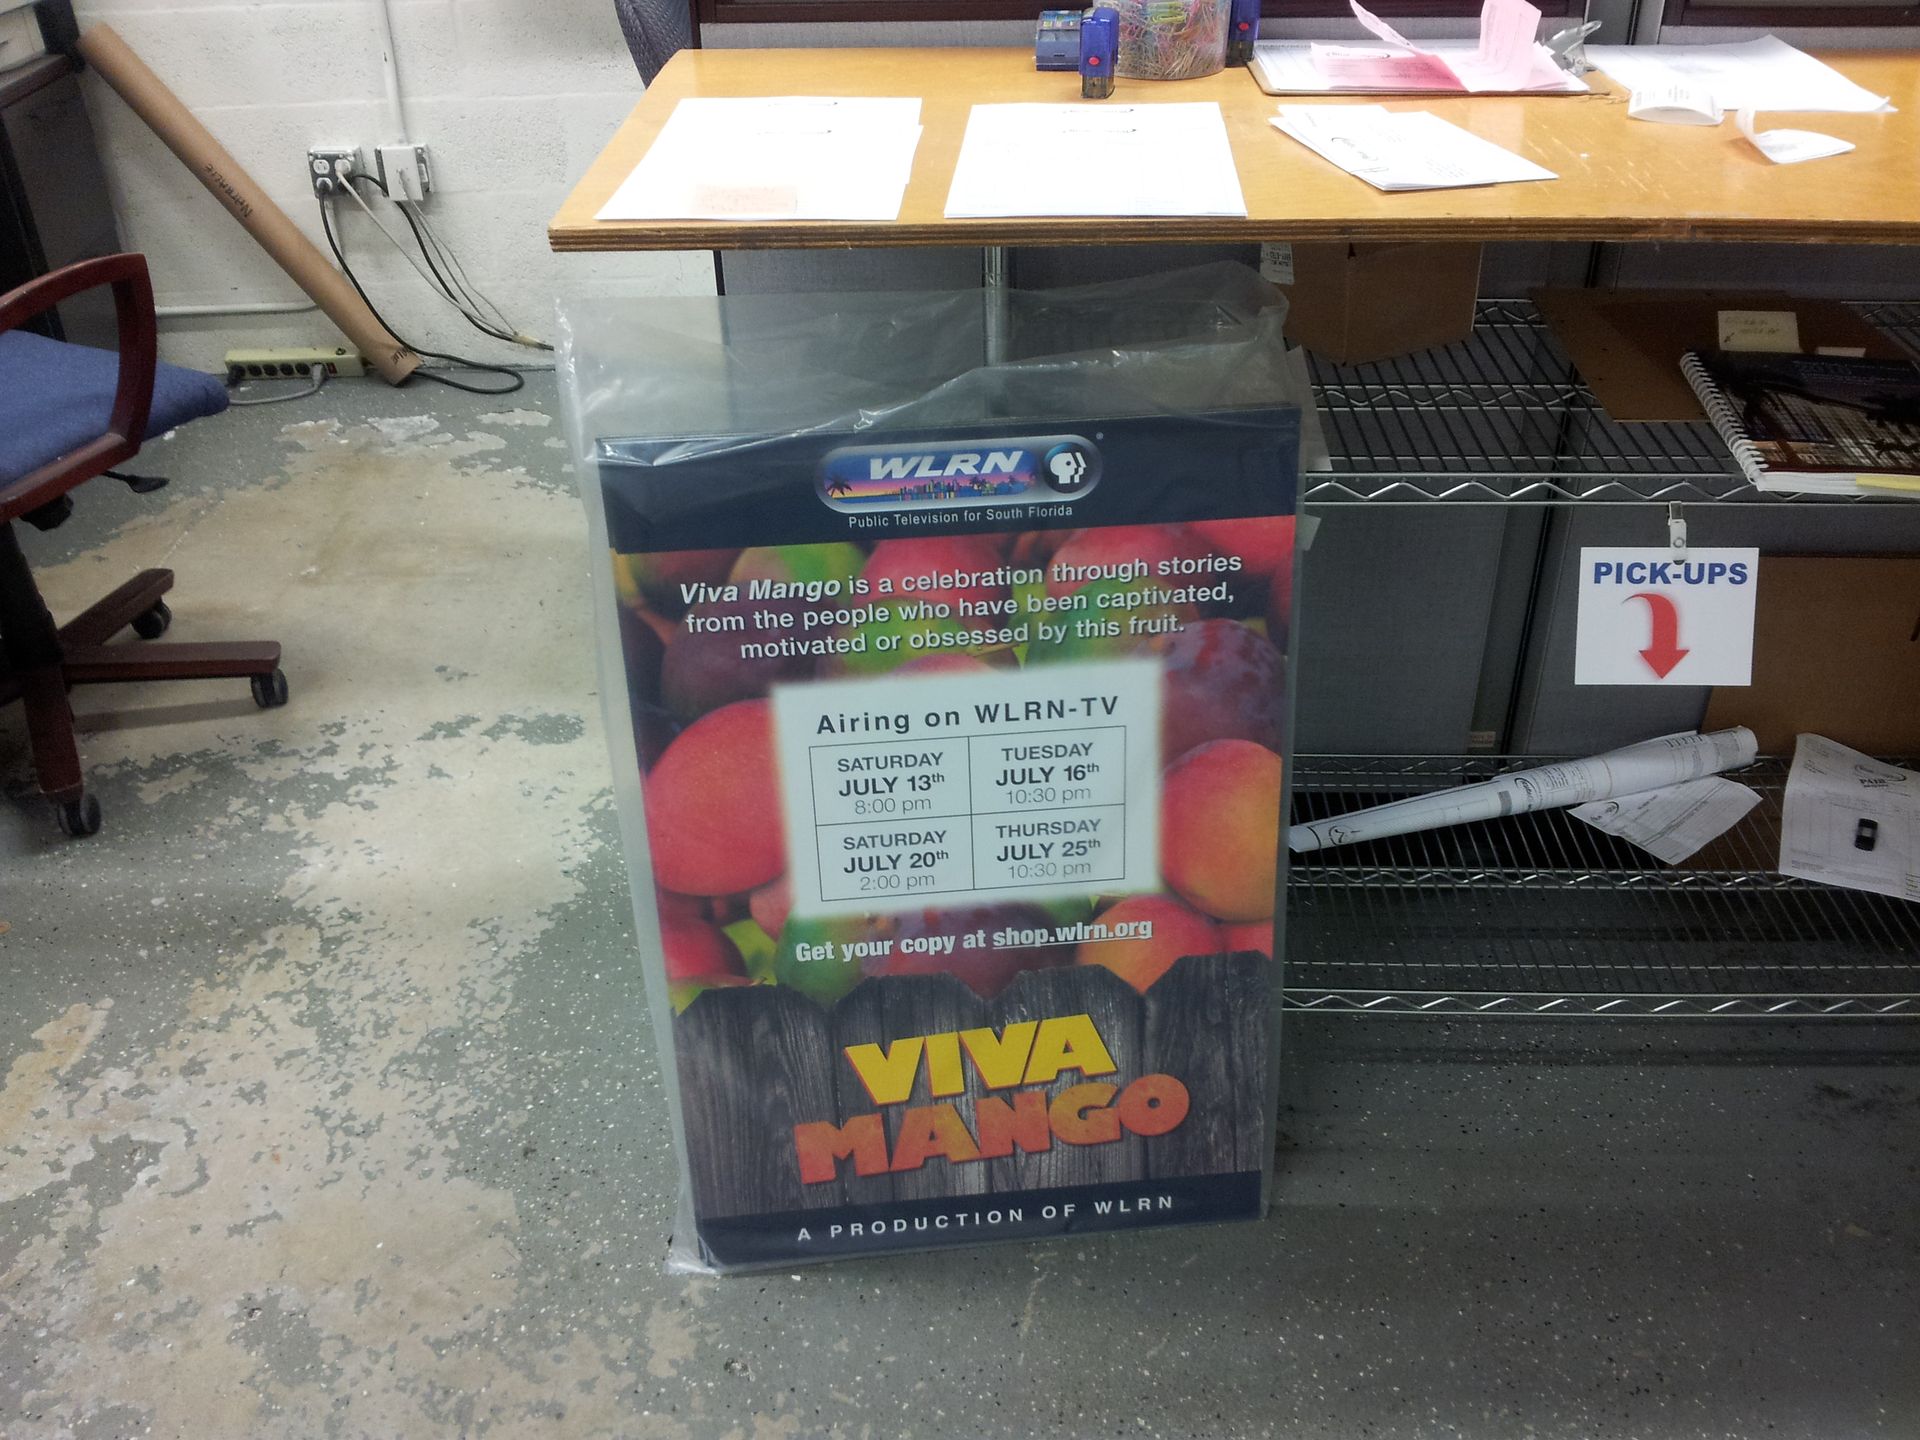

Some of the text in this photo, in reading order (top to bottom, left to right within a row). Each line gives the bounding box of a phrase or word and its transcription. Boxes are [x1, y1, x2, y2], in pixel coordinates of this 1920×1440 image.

[869, 450, 1024, 480] WLRN
[849, 505, 1073, 528] Public Television for South Florida
[680, 554, 1242, 604] Viva Mango is a celebration through stories
[1593, 562, 1748, 585] PICK-UPS
[685, 582, 1235, 634] from the people who have been captivated,
[740, 614, 1185, 659] motivated or obsessed by this fruit.
[817, 696, 1118, 734] Airing on WLRN-TV
[837, 752, 943, 772] SATURDAY
[1001, 743, 1093, 762] TUESDAY
[838, 773, 945, 797] JULY 13th
[995, 762, 1099, 787] JULY 16th
[854, 797, 932, 815] 8:00 pm
[1006, 787, 1091, 805] 10:30 pm
[843, 830, 947, 850] SATURDAY
[996, 819, 1101, 839] THURSDAY
[844, 849, 949, 874] JULY 20th
[996, 837, 1101, 862] JULY 25th
[860, 874, 935, 891] 2:00 pm
[1008, 861, 1091, 879] 10:30 pm
[796, 920, 1153, 962] Get your copy at shop.wlrn.org
[843, 1013, 1118, 1106] VIVA
[794, 1073, 1190, 1185] MANGO
[797, 1195, 1173, 1241] A PRODUCTION OF WLRN
